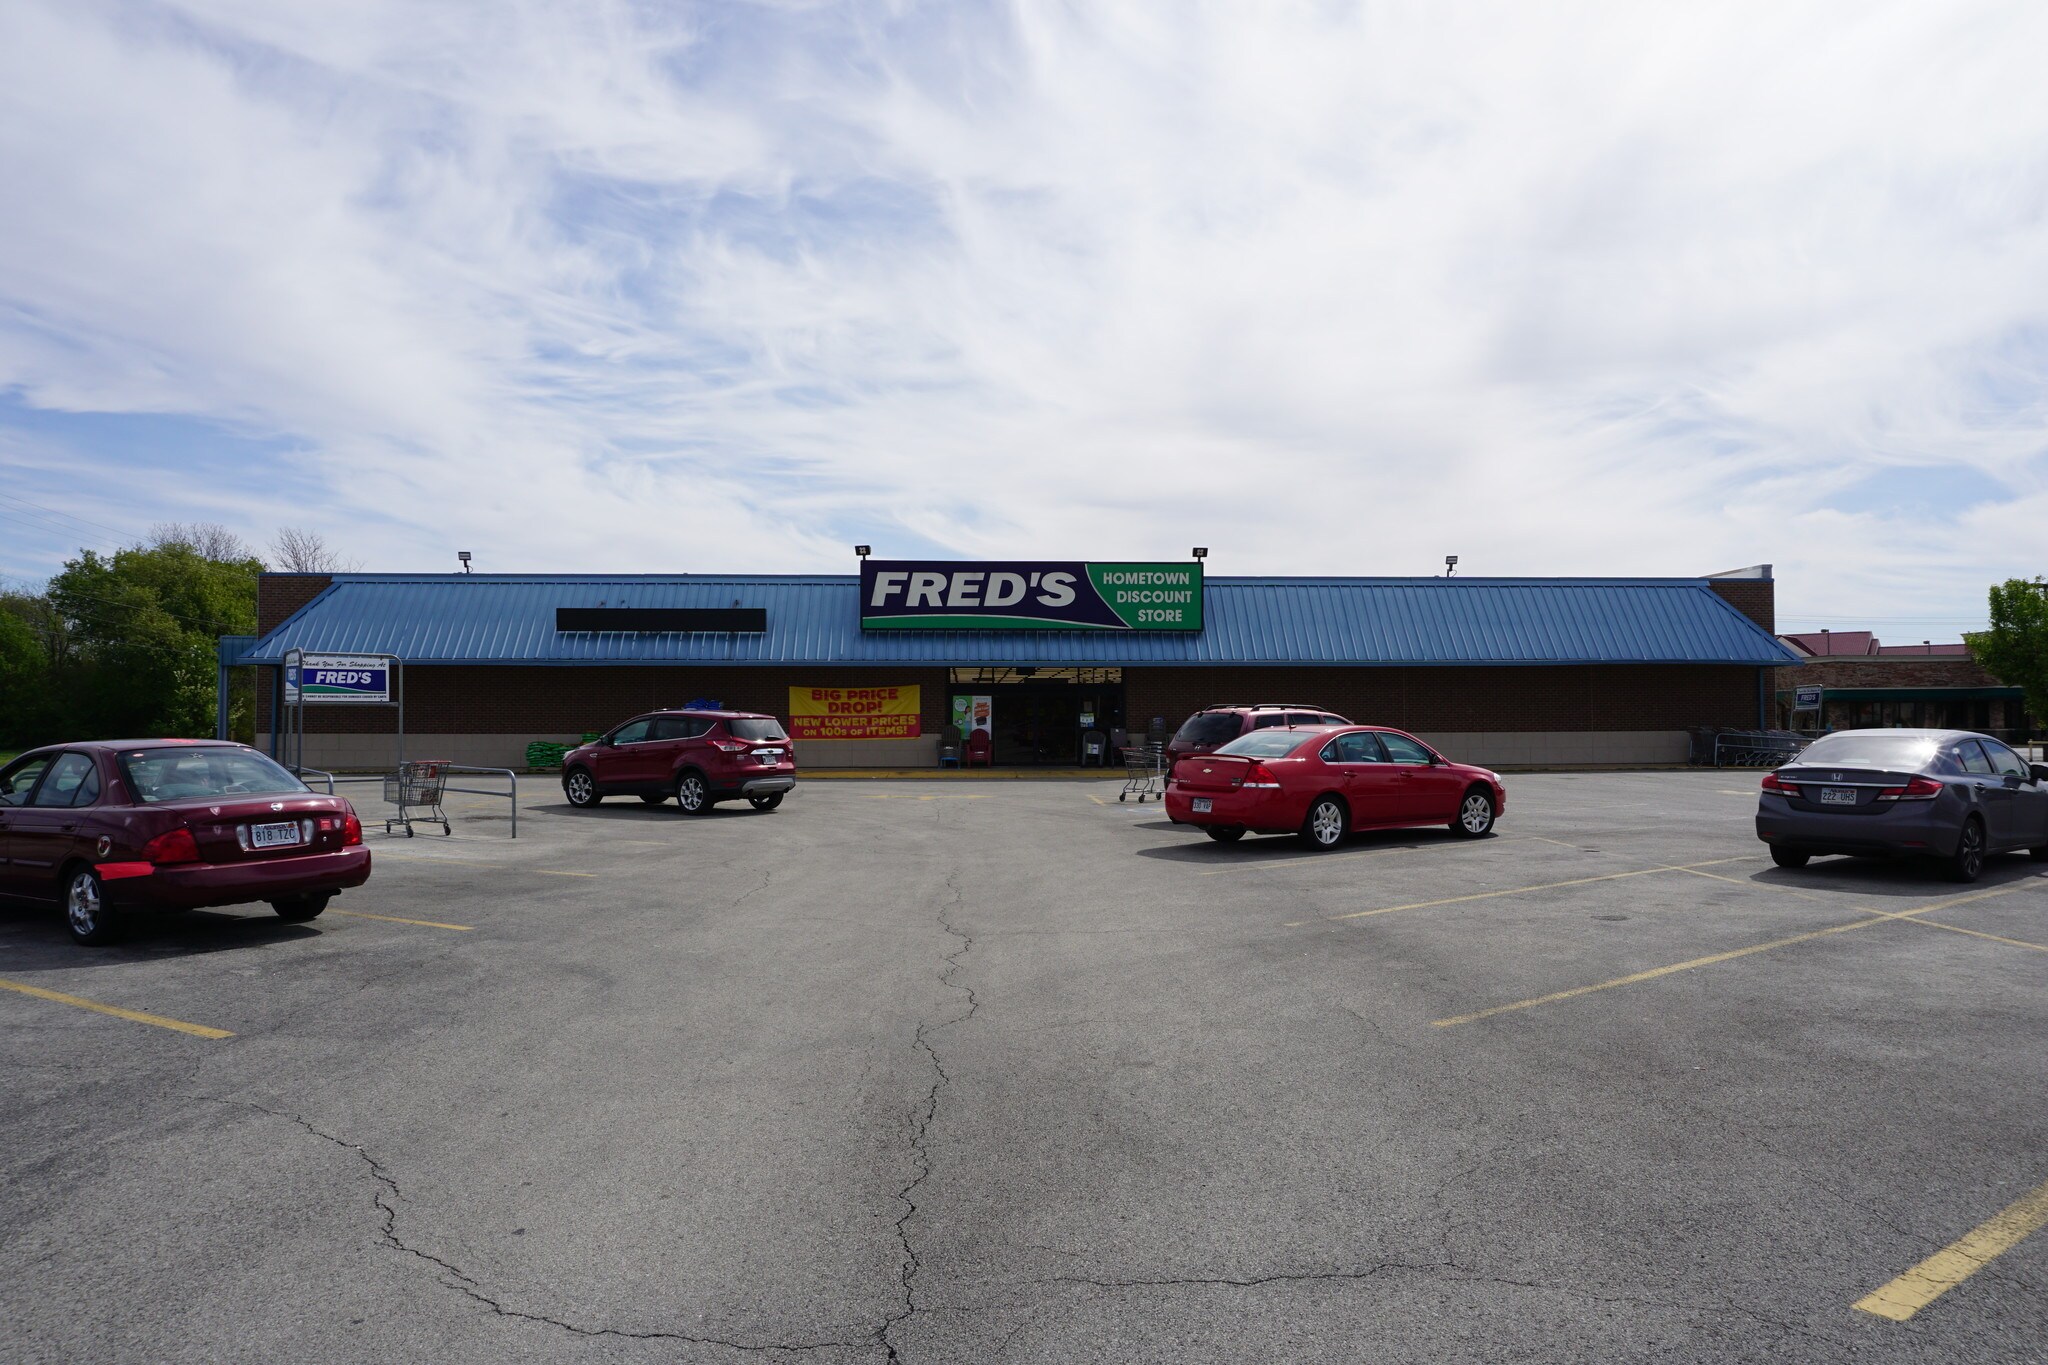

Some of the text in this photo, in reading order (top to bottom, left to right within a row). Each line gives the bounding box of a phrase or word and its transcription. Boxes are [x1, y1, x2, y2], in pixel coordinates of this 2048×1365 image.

[1103, 572, 1190, 585] HOMETOWN
[870, 572, 1078, 607] FRED'S
[1117, 590, 1193, 603] DISCOUNT
[1137, 609, 1182, 622] STORE
[322, 660, 334, 668] You
[315, 671, 372, 684] FRED'S
[812, 688, 899, 700] BIG PRICE
[828, 701, 883, 714] DROP!
[794, 715, 917, 727] NEW LOWER PRICES
[850, 728, 863, 736] OF
[866, 726, 908, 735] ITEMS!
[1822, 792, 1836, 801] 222
[255, 828, 295, 842] 818 TZC
